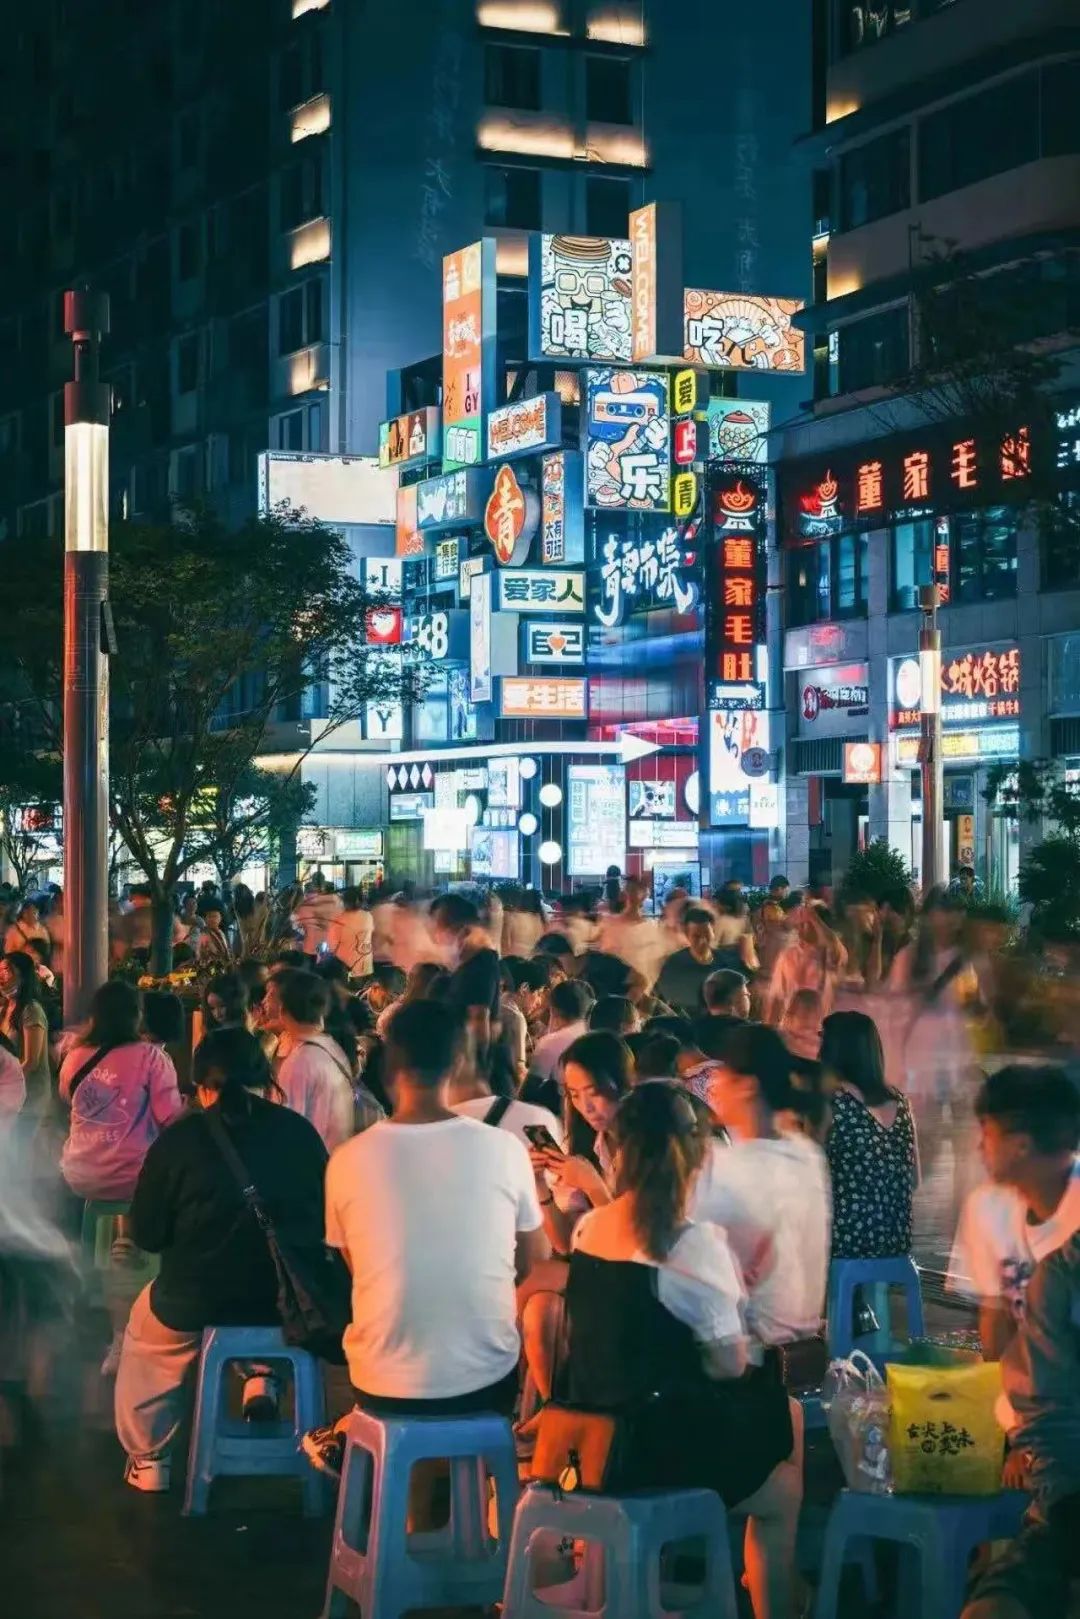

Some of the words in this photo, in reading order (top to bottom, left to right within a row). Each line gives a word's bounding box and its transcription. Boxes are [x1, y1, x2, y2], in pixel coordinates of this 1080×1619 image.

[635, 213, 650, 354] WELCOME
[549, 308, 588, 350] 喝
[688, 314, 725, 352] 吃
[464, 393, 479, 413] GY
[620, 454, 661, 500] 乐
[504, 577, 583, 602] 爱家人
[724, 538, 753, 681] 董家毛肚
